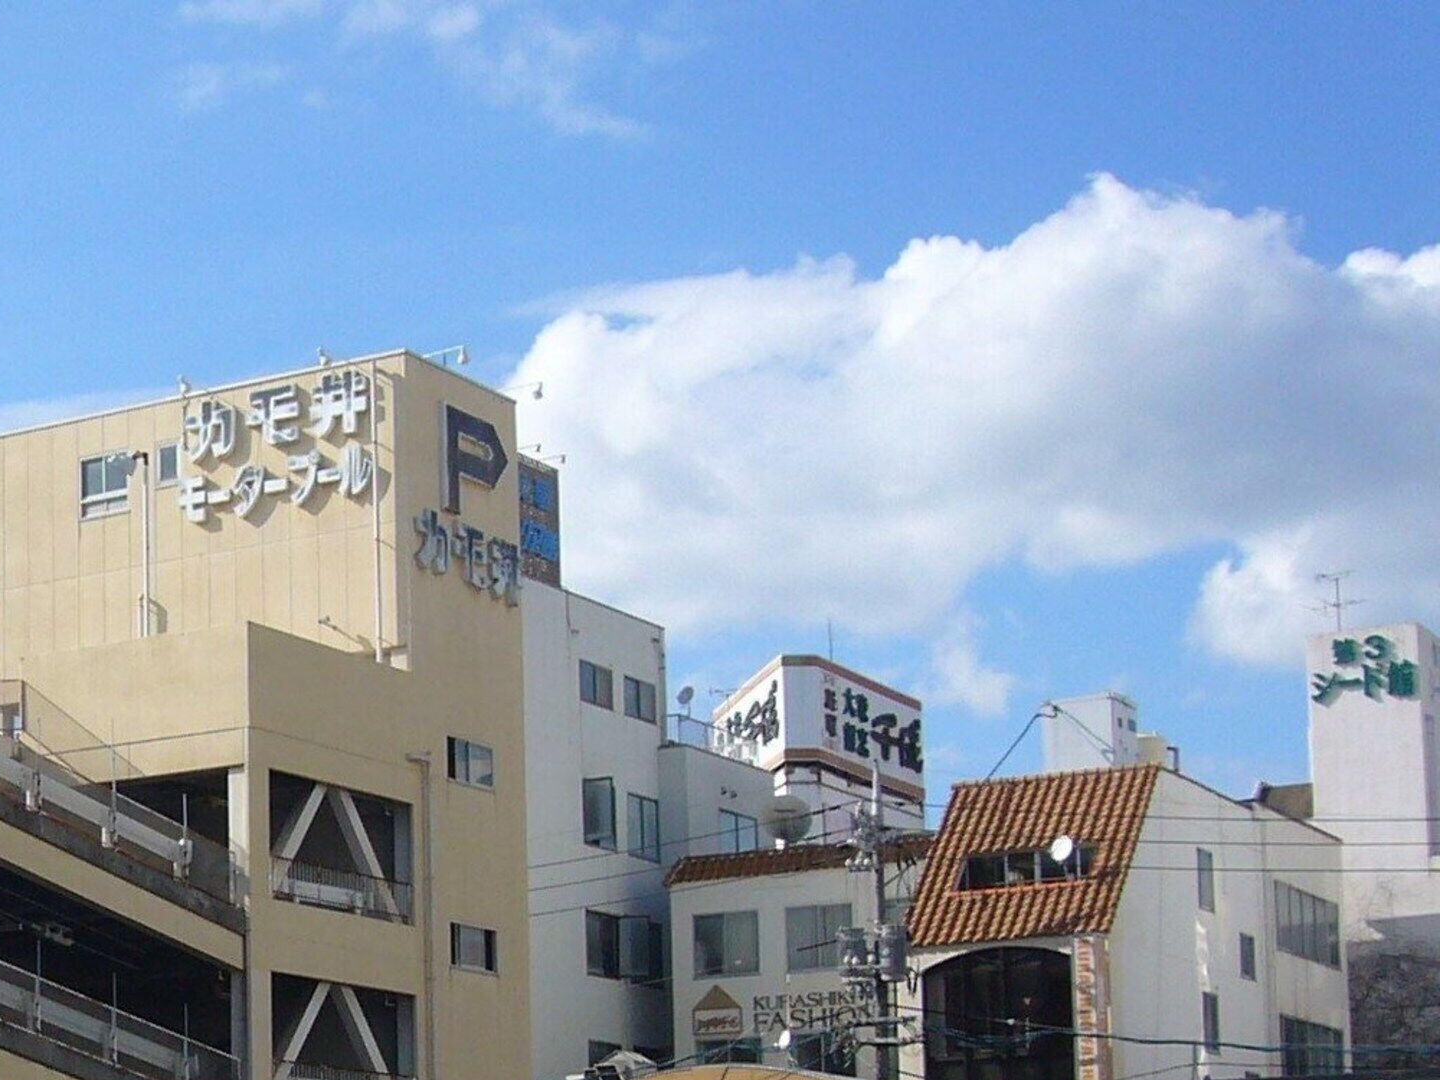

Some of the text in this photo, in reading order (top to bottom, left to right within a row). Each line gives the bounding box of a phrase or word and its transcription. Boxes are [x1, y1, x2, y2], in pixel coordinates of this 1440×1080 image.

[185, 371, 370, 460] カモ井
[179, 445, 372, 523] モータープール
[414, 507, 520, 607] カモ井
